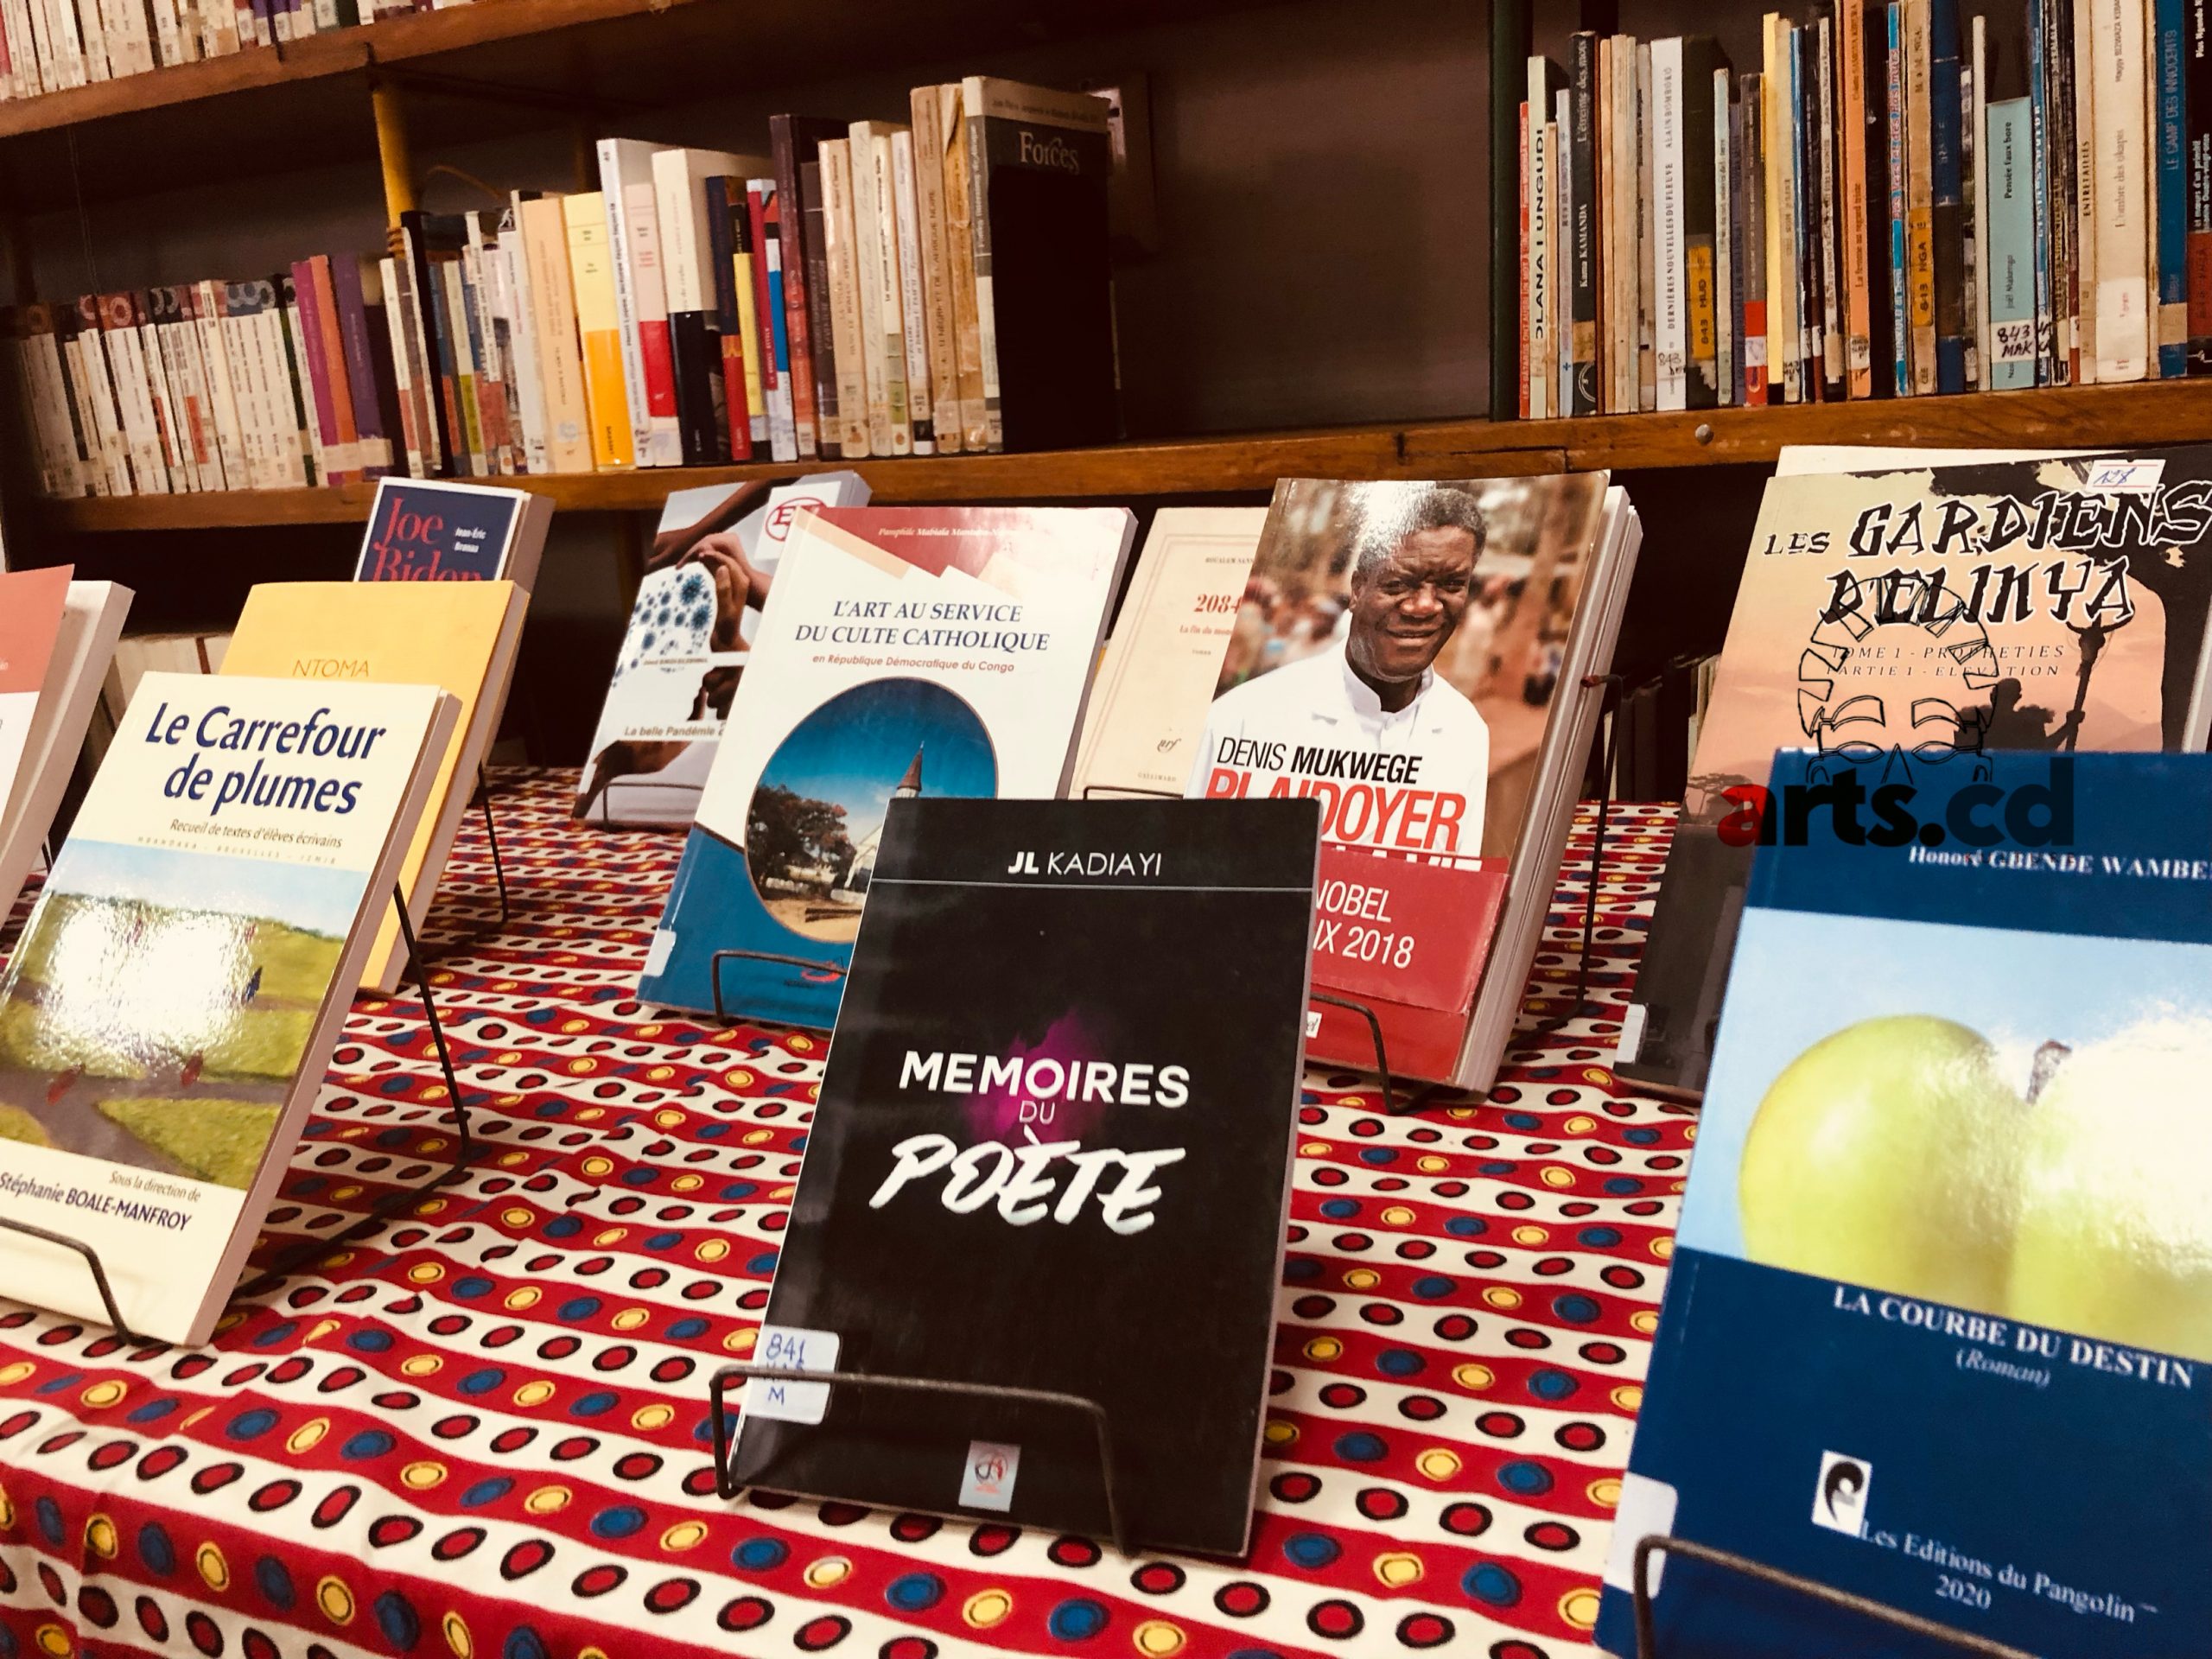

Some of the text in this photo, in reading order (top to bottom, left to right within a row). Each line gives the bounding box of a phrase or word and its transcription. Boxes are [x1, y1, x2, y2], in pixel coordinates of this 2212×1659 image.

[2164, 29, 2178, 170] LE CAMP DES INNOCENTS
[1018, 130, 1081, 175] Forces
[1664, 162, 1674, 201] FLEUVE
[1665, 202, 1674, 216] DU
[1579, 203, 1587, 258] KAMANDA
[1665, 217, 1675, 274] NOUVELLES
[1998, 324, 2031, 344] 843
[2001, 340, 2032, 358] MAK
[374, 497, 443, 548] Joe
[1764, 480, 2212, 558] LES GARDIENS
[833, 601, 1023, 622] L'ART AU SERVICE
[1194, 593, 1243, 614] 2084
[795, 625, 1051, 654] DU CULTE CATHOLIQUE
[1832, 645, 1886, 658] TOME
[1923, 645, 2065, 659] PROPHETIES
[292, 658, 369, 677] NTOMA
[811, 653, 1015, 674] en République Démocratique du Congo
[1827, 664, 1897, 677] PARTIE
[1935, 664, 2060, 677] ELEVATION
[145, 702, 387, 760] Le Carrefour
[1217, 737, 1423, 785] DENIS MUKWEGE
[163, 752, 364, 817] de plumes
[169, 818, 344, 849] Recueil de textes d'élèves écrivains
[1007, 851, 1163, 877] JL KADIAYI
[1988, 849, 2094, 874] GBENDE
[2101, 855, 2212, 880] WAMBE
[1343, 925, 1415, 970] 2018
[899, 1049, 1191, 1109] MEMOIRES
[1018, 1100, 1056, 1124] DU
[109, 1170, 201, 1203] Sous la direction de
[868, 1123, 1186, 1236] POÈTE
[0, 1171, 193, 1232] Stéphanie BOALE-MANFROY
[766, 1333, 806, 1361] 841
[1833, 1285, 2194, 1389] LA COURBE DU DESTIN
[1955, 1347, 2051, 1389] (Roman)
[767, 1385, 785, 1407] M
[1859, 1517, 2136, 1625] Les Editions du Pangolin
[1935, 1573, 1993, 1611] 2020
